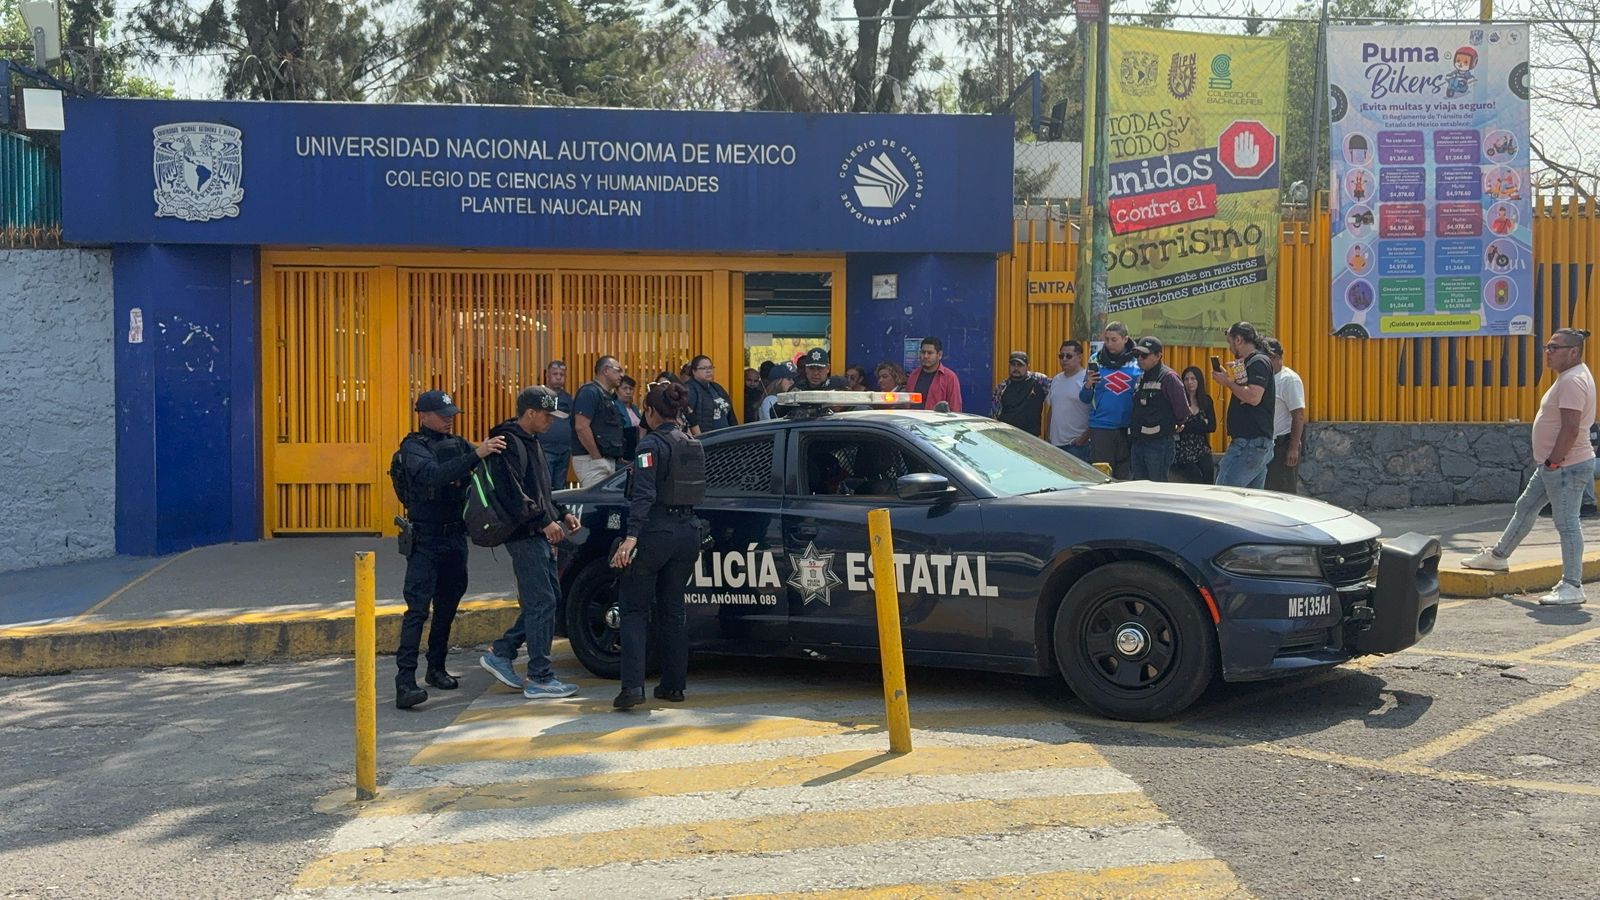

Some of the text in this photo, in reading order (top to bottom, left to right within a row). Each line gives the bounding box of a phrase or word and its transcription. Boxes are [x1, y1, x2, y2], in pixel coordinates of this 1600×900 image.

[1179, 53, 1196, 66] IPN
[1362, 42, 1439, 63] Puma
[1364, 63, 1447, 100] Bikers
[1206, 96, 1263, 105] BACHILLERES
[1360, 102, 1496, 112] ¡Evita multas y viaja seguro!
[1109, 109, 1190, 136] TODAS y
[296, 136, 796, 165] UNIVERSIDAD NACIONAL AUTONOMA DE MEXICO
[1110, 130, 1180, 158] TODOS
[385, 170, 720, 192] COLEGIO DE CIENCIAS Y HUMANIDADES
[839, 140, 876, 178] COLEGIO
[882, 139, 896, 148] DE
[900, 146, 924, 198] CIENCIAS
[461, 196, 642, 216] PLANTEL NAUCALPAN
[1116, 191, 1206, 223] contra el
[1114, 280, 1158, 296] violencia
[1161, 279, 1172, 287] no
[1174, 272, 1197, 283] cabe
[1200, 270, 1211, 278] en
[1214, 259, 1257, 276] nuestras
[1108, 273, 1257, 312] instituciones educativas
[686, 542, 781, 588] LICÍA
[711, 592, 757, 604] ANÓNIMA
[760, 594, 777, 605] 089
[1288, 594, 1331, 618] ME135A1
